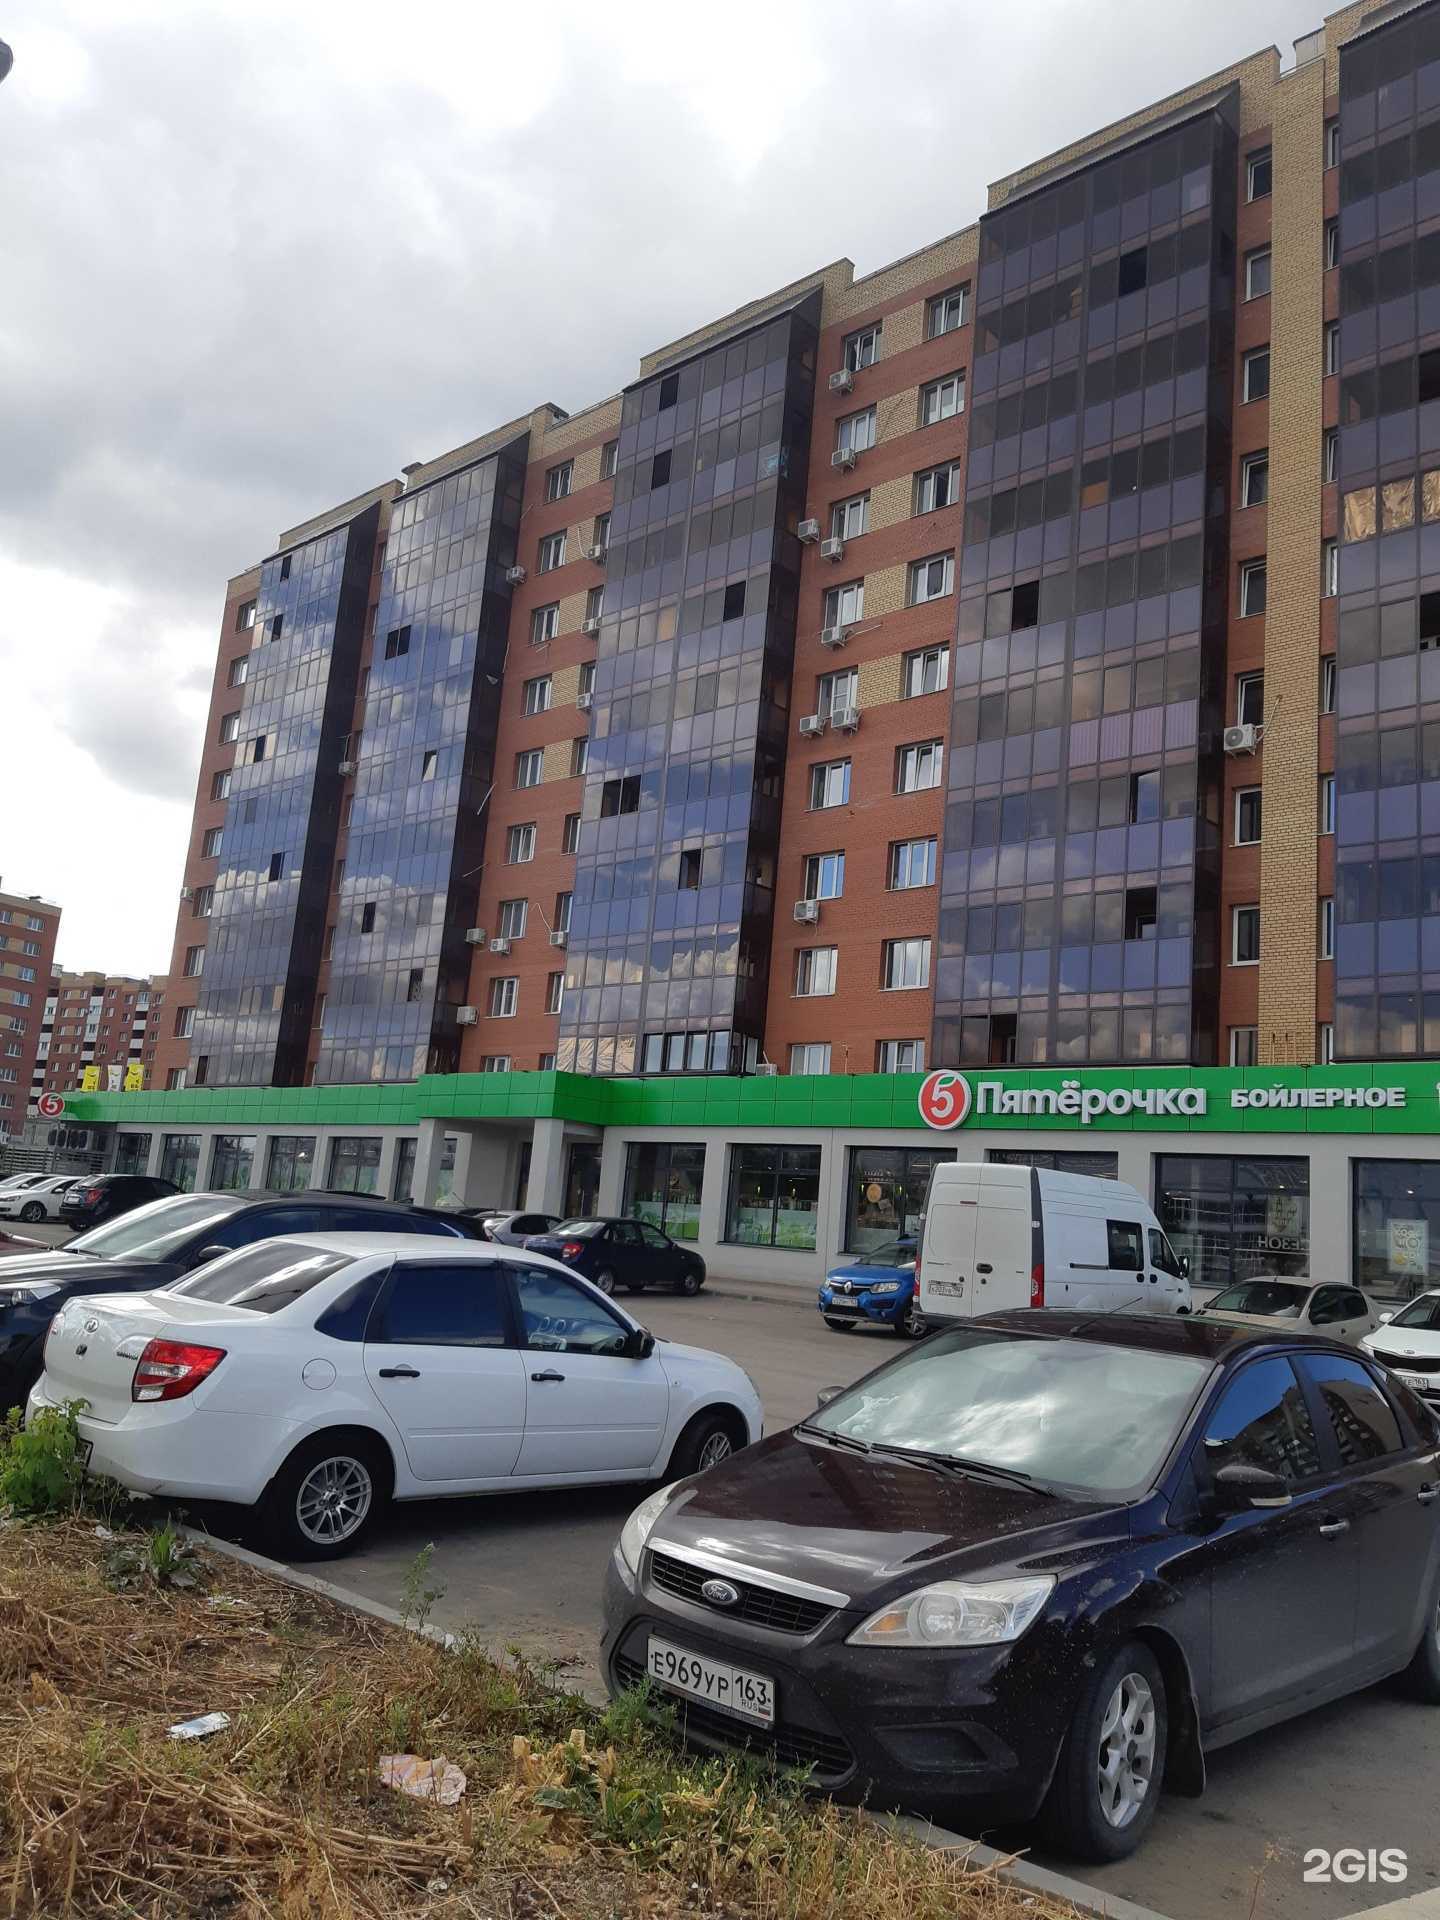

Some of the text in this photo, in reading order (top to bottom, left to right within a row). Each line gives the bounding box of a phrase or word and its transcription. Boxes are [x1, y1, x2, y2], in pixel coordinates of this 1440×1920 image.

[976, 1080, 1207, 1124] Пятёрочка
[1231, 1084, 1406, 1108] БОЙЛЕРНОЕ
[707, 1584, 729, 1601] Ford
[741, 1698, 759, 1713] RUS
